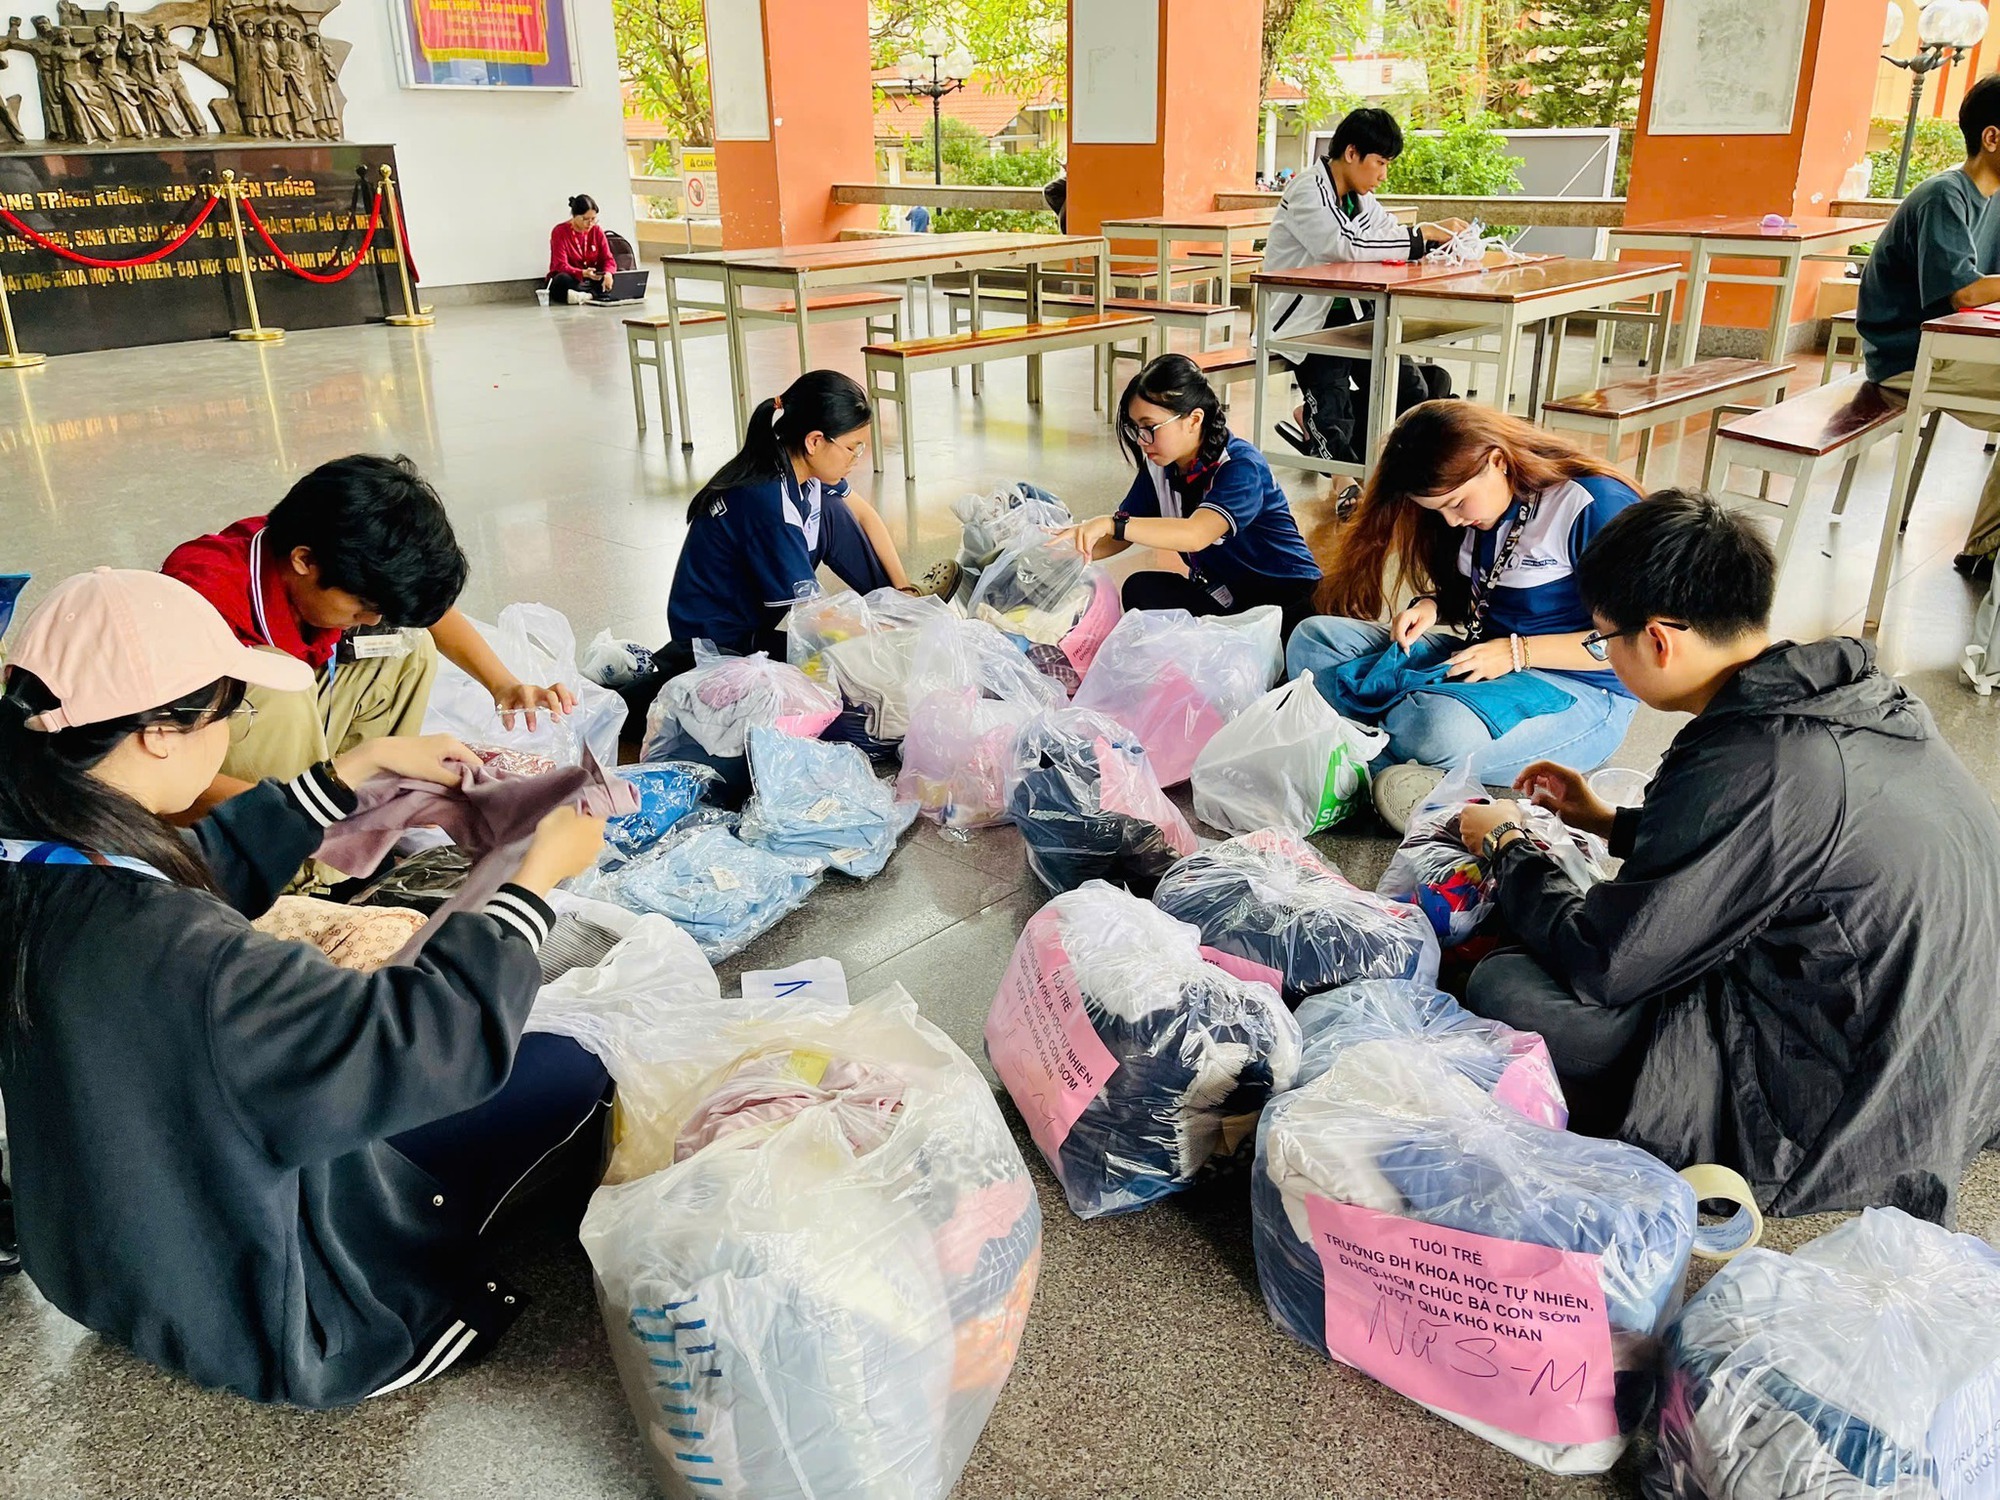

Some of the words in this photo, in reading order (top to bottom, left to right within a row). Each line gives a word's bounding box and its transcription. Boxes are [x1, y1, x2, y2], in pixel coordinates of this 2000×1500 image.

[264, 176, 316, 197] THỐNG
[74, 229, 106, 247] SINH
[107, 225, 137, 244] VIÊN
[89, 267, 115, 287] HỌC
[1039, 982, 1054, 1013] KHOA
[1023, 1005, 1034, 1031] QUA
[1048, 1039, 1062, 1065] CON
[1058, 1062, 1079, 1090] SỚM
[1451, 1246, 1483, 1266] TRẺ
[1323, 1232, 1385, 1264] TRƯỜNG
[1389, 1254, 1411, 1271] ĐH
[1415, 1260, 1460, 1285] KHOA
[1463, 1274, 1498, 1294] HỌC
[1502, 1284, 1529, 1304] TỰ
[1533, 1290, 1594, 1312] NHIÊN,
[1339, 1253, 1415, 1292] ĐHQG-HCM
[1419, 1283, 1464, 1305] CHÚC
[1468, 1296, 1491, 1313] BÀ
[1496, 1304, 1533, 1320] CON
[1538, 1310, 1581, 1324] SỚM
[1417, 1299, 1450, 1321] QUA
[1453, 1311, 1489, 1331] KHÓ
[1493, 1321, 1542, 1342] KHĂN
